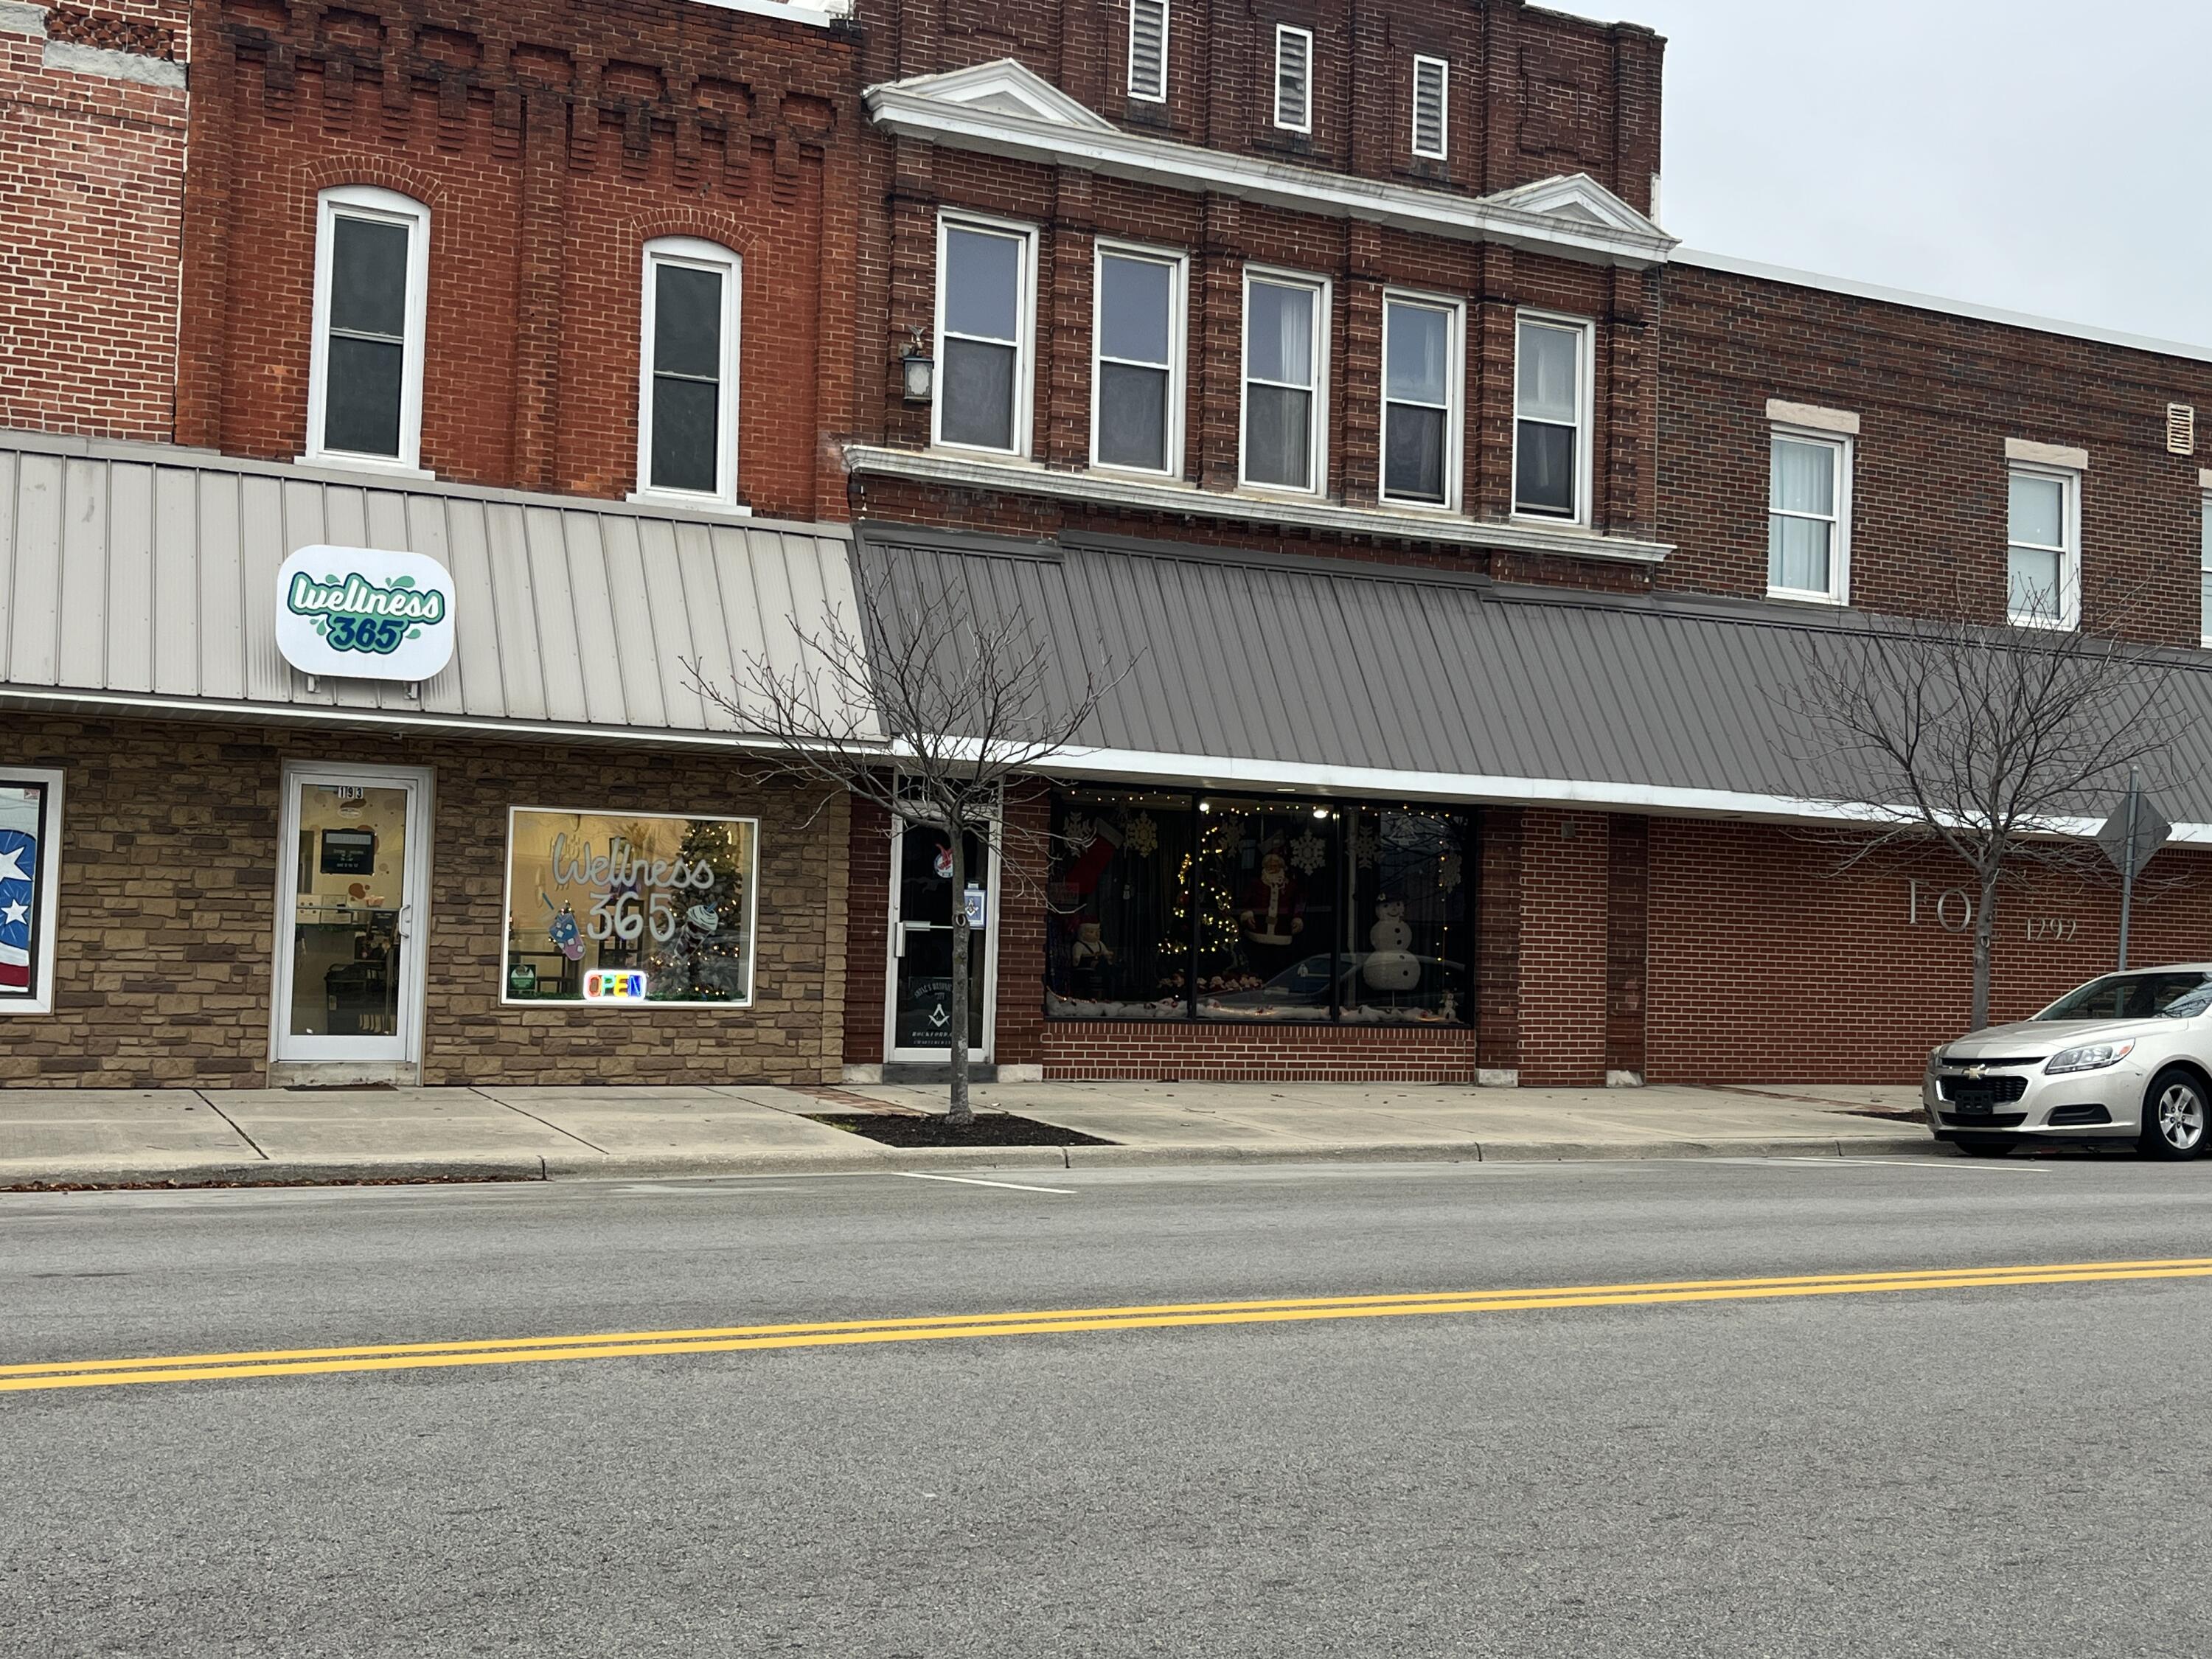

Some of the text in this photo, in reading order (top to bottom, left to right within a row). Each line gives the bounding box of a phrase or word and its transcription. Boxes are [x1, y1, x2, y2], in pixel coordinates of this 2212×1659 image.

[333, 616, 404, 649] 365
[339, 786, 363, 799] 193
[553, 832, 714, 889] Wellness
[587, 891, 676, 942] 365
[1908, 878, 2076, 942] FO 1292
[588, 973, 644, 998] OPEN
